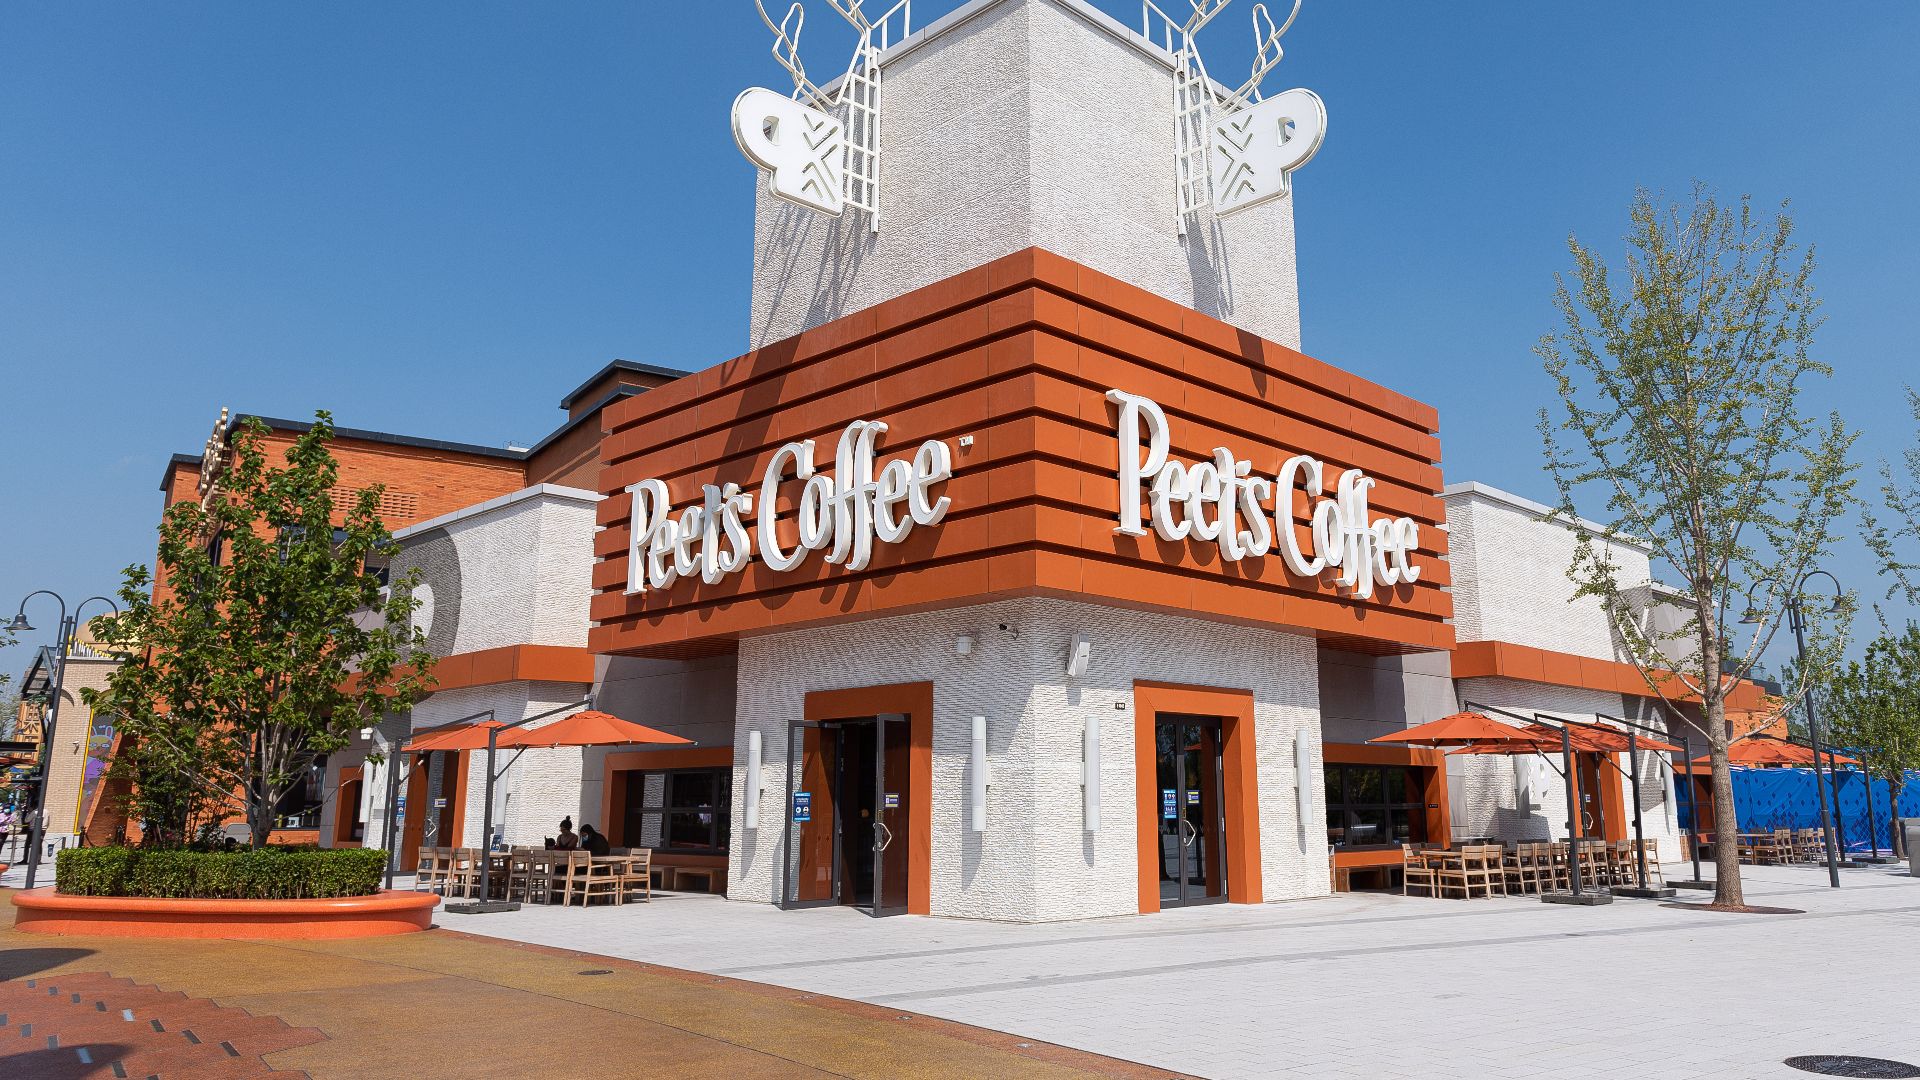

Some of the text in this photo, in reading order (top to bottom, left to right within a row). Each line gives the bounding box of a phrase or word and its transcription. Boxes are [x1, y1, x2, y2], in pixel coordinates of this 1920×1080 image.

[623, 478, 754, 596] Peet's
[757, 419, 952, 573] Coffee
[1105, 388, 1421, 600] Peet's Coffee
